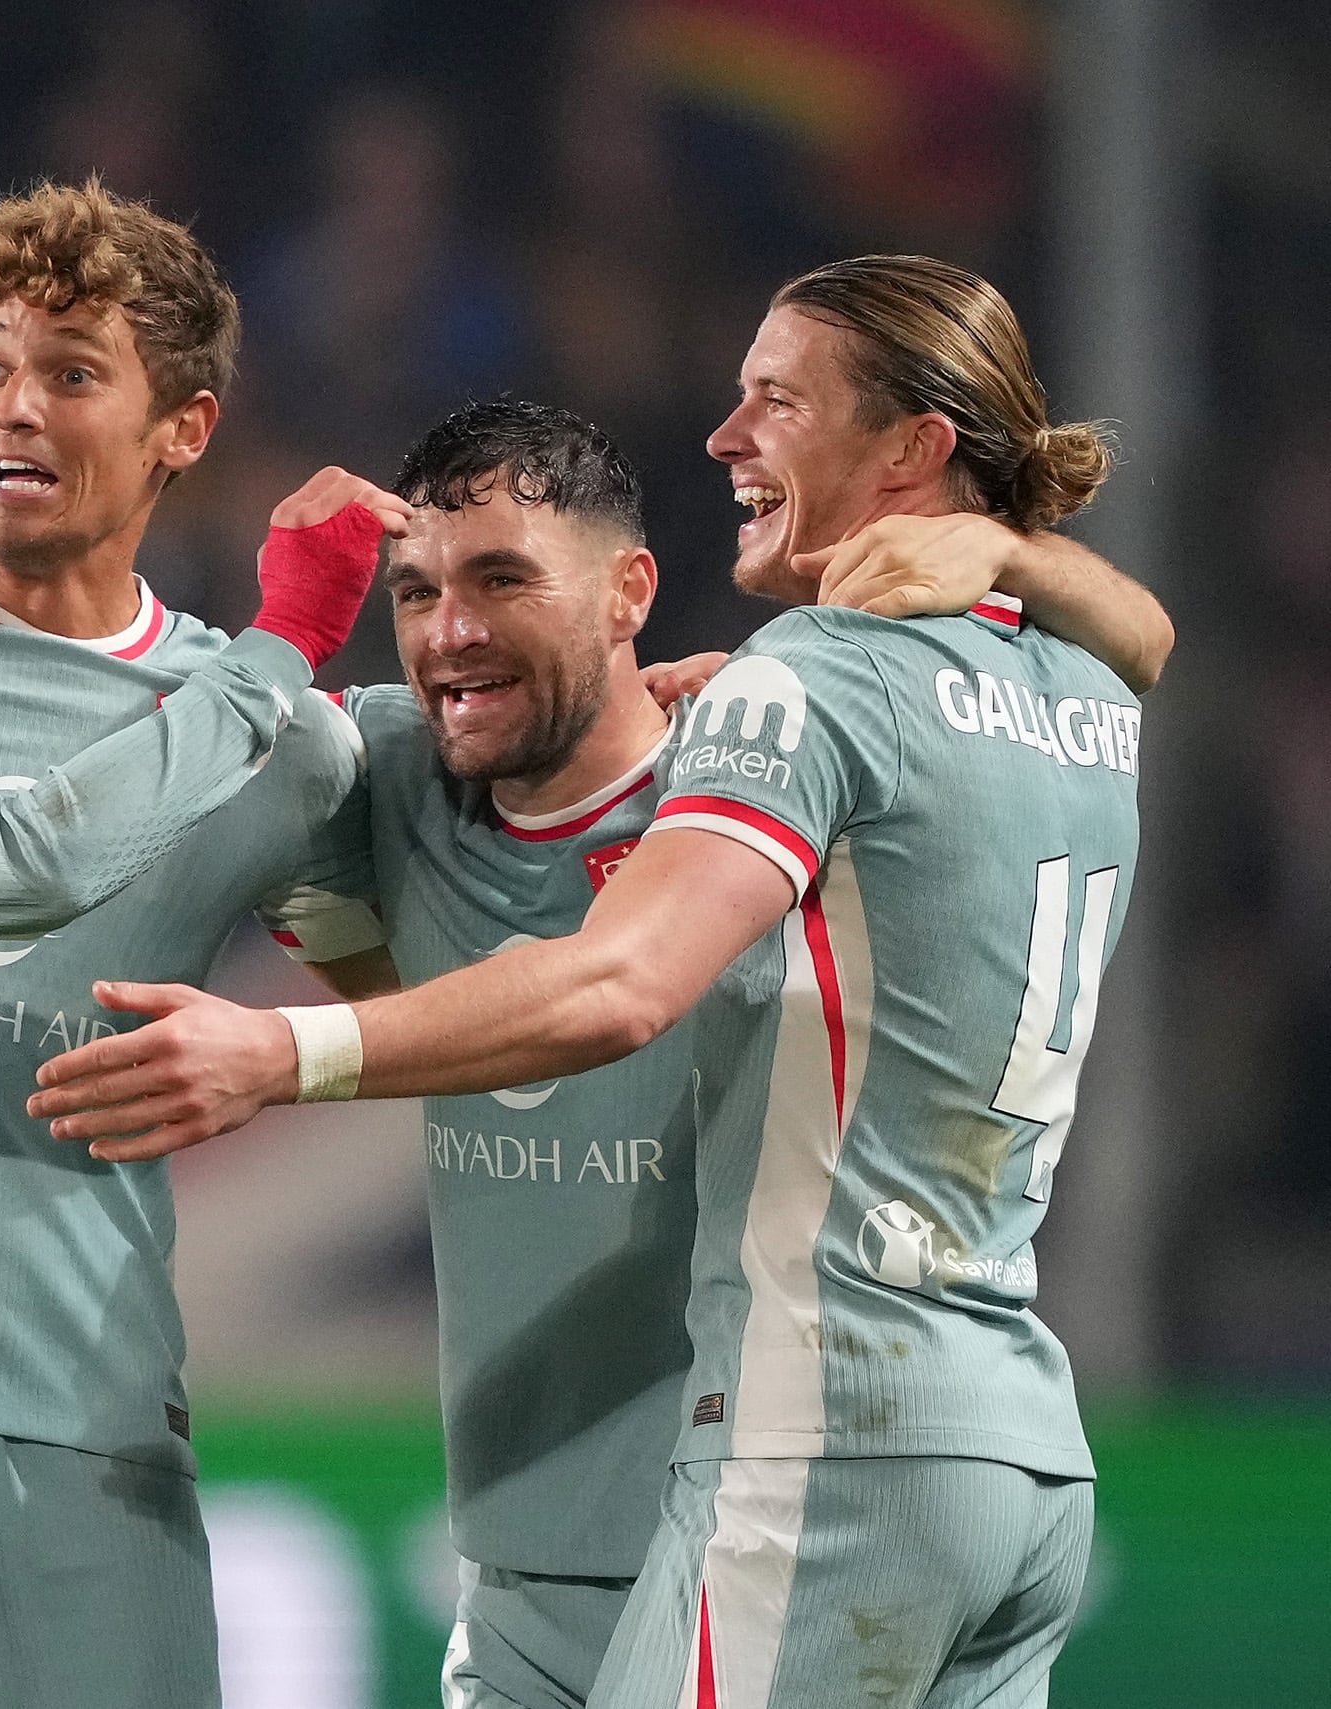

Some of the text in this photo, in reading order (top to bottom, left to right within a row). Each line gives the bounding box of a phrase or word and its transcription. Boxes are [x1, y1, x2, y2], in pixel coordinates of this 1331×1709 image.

[674, 744, 791, 790] kraken
[989, 853, 1119, 1203] 4
[428, 1122, 667, 1184] RIYADH AIR
[943, 1247, 1004, 1282] Save
